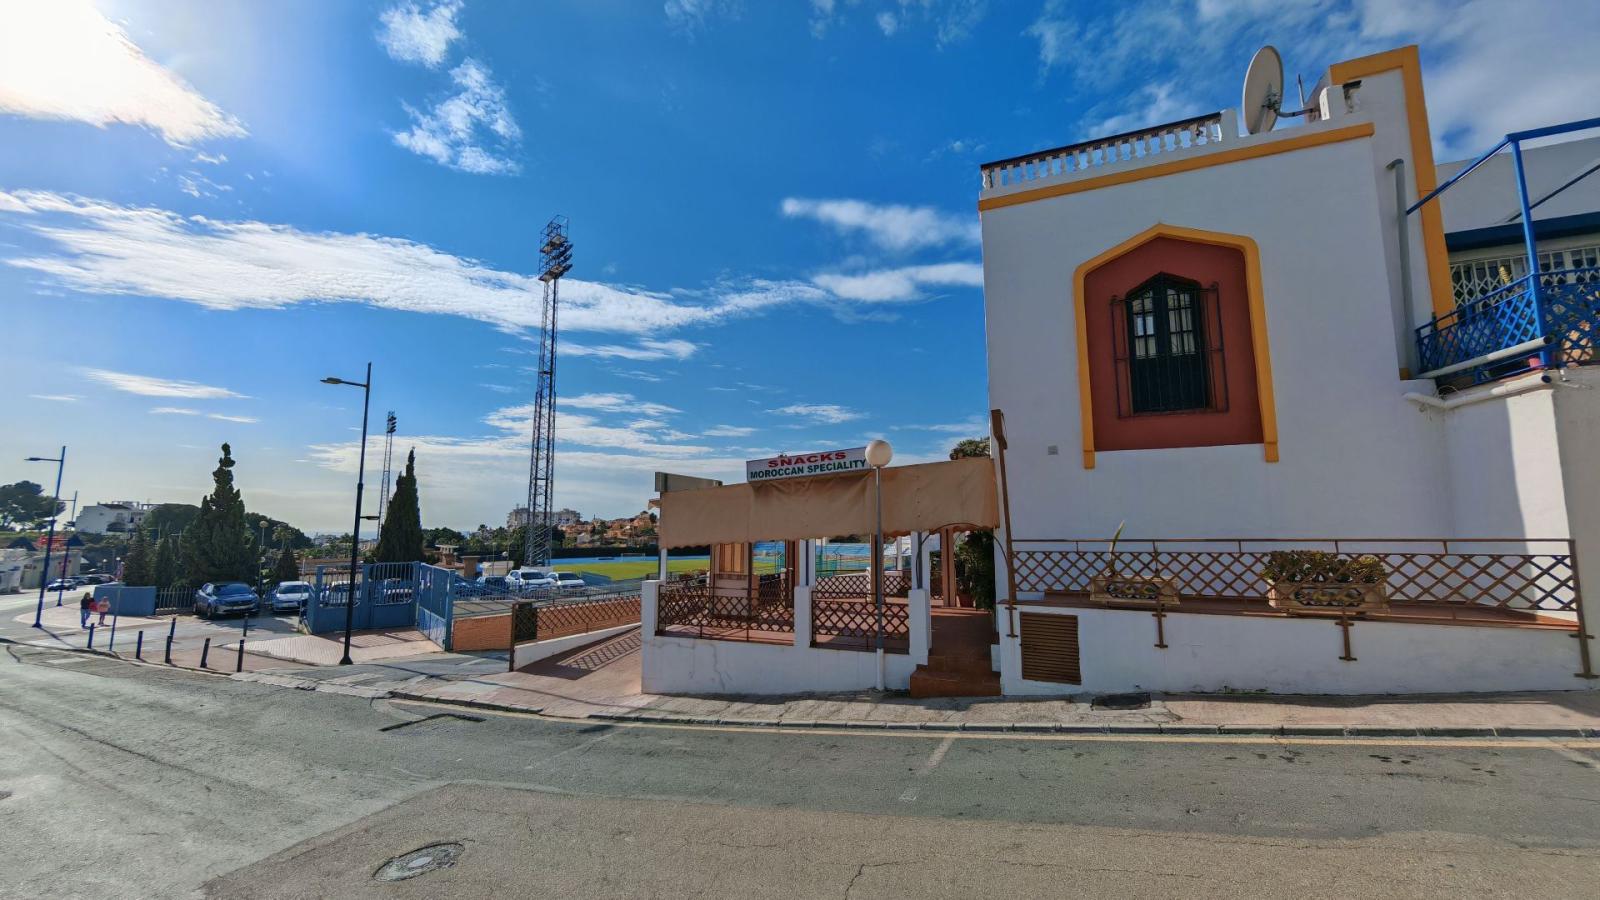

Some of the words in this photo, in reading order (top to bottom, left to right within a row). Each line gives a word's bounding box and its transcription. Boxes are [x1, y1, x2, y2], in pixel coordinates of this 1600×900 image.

[768, 452, 847, 467] SNACKS
[750, 466, 804, 479] MOROCCAN
[807, 459, 866, 473] SPECIALITY
